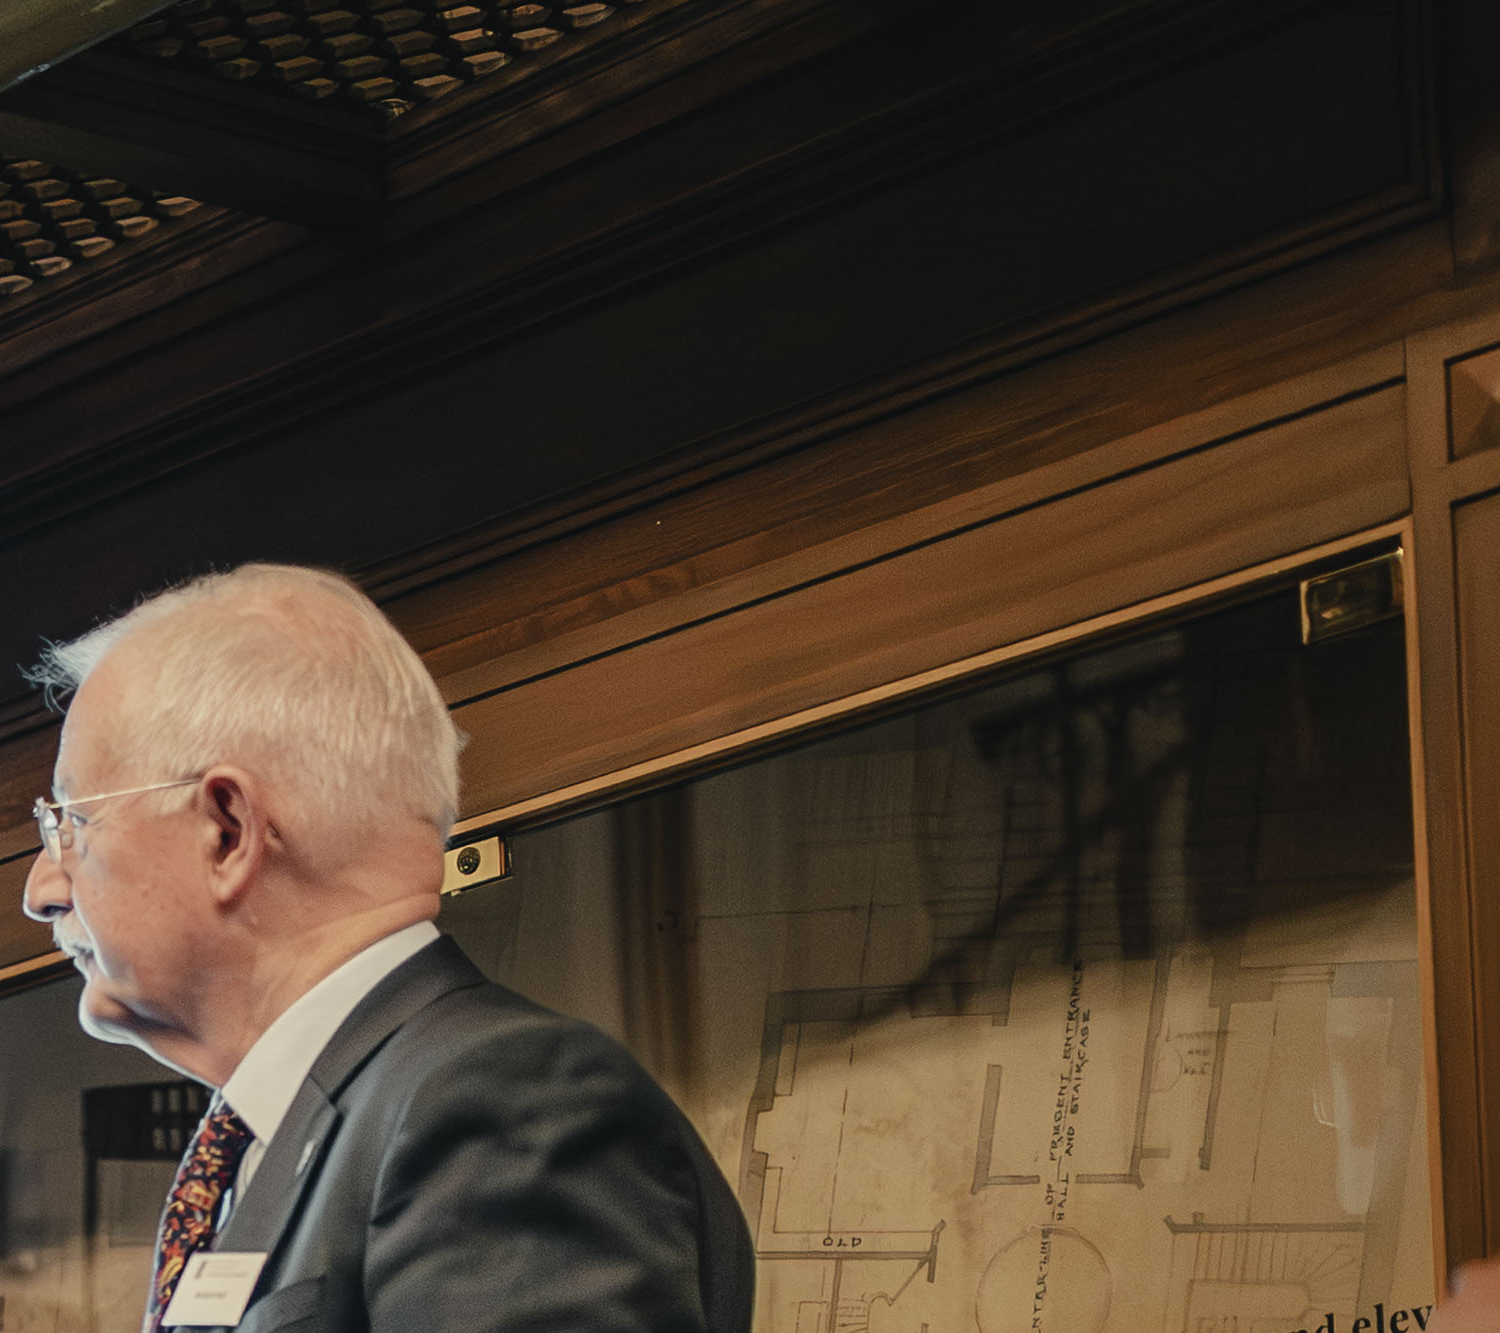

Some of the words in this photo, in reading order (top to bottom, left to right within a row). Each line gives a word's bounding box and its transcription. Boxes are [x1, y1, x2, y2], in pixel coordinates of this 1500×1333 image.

[1056, 1172, 1069, 1221] HALL
[1064, 1126, 1075, 1157] AND
[1070, 1008, 1090, 1114] STAIRCASE
